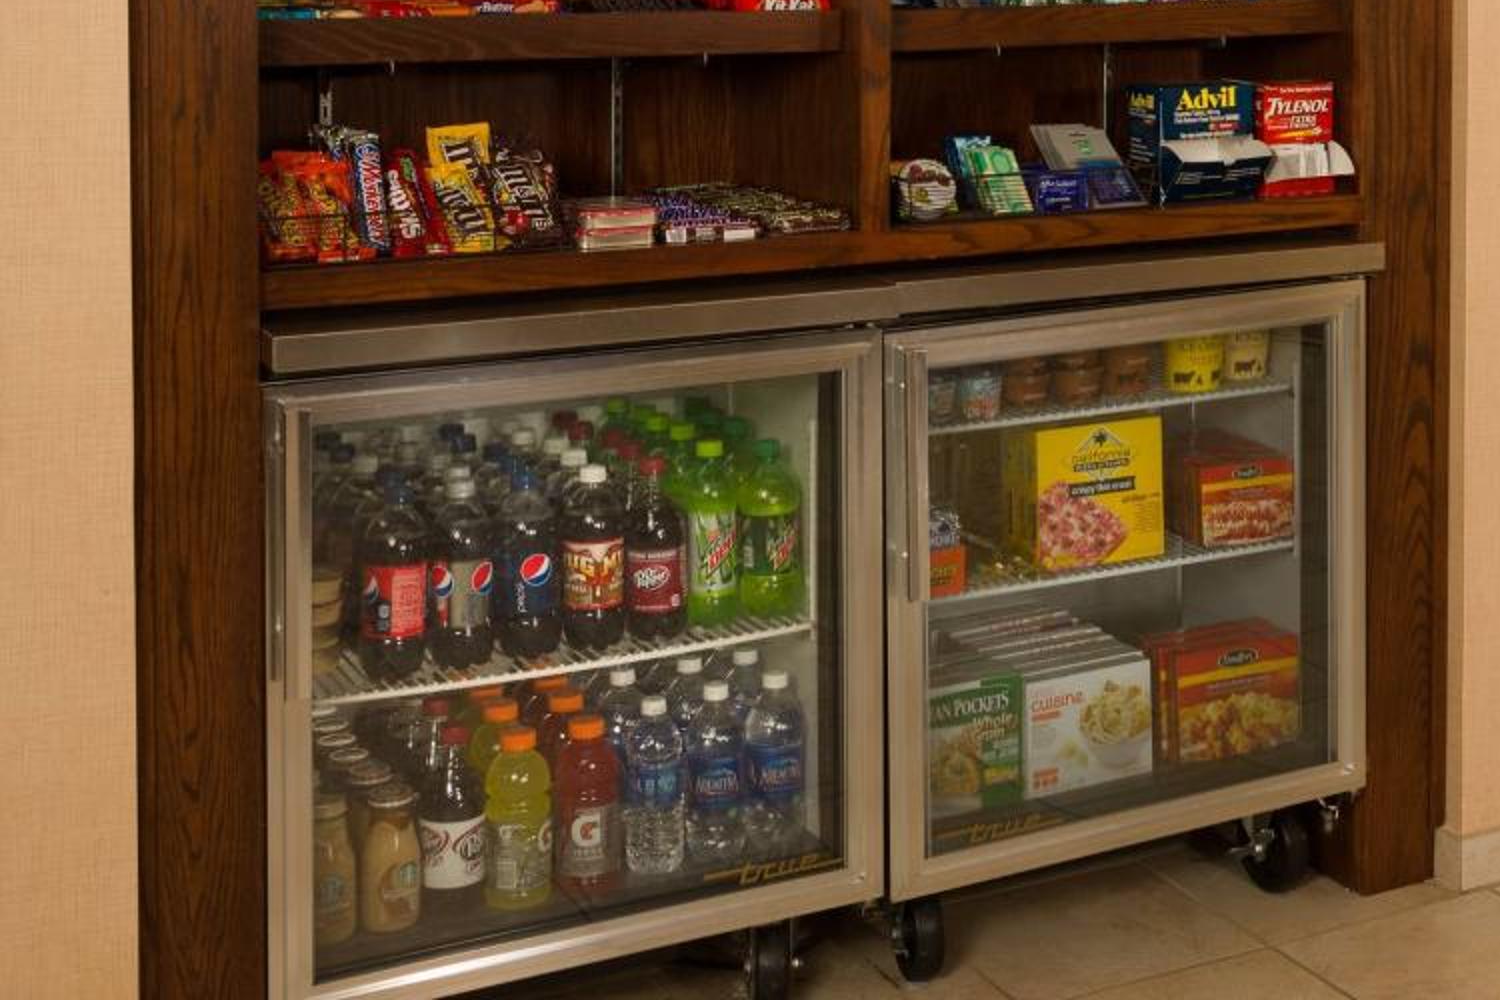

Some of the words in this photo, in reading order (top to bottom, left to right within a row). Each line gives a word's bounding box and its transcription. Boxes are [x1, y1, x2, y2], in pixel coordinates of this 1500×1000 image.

[1177, 86, 1238, 111] Advil
[1265, 97, 1329, 119] TYLENOL
[953, 694, 1009, 716] POCKETS
[739, 855, 818, 885] true
